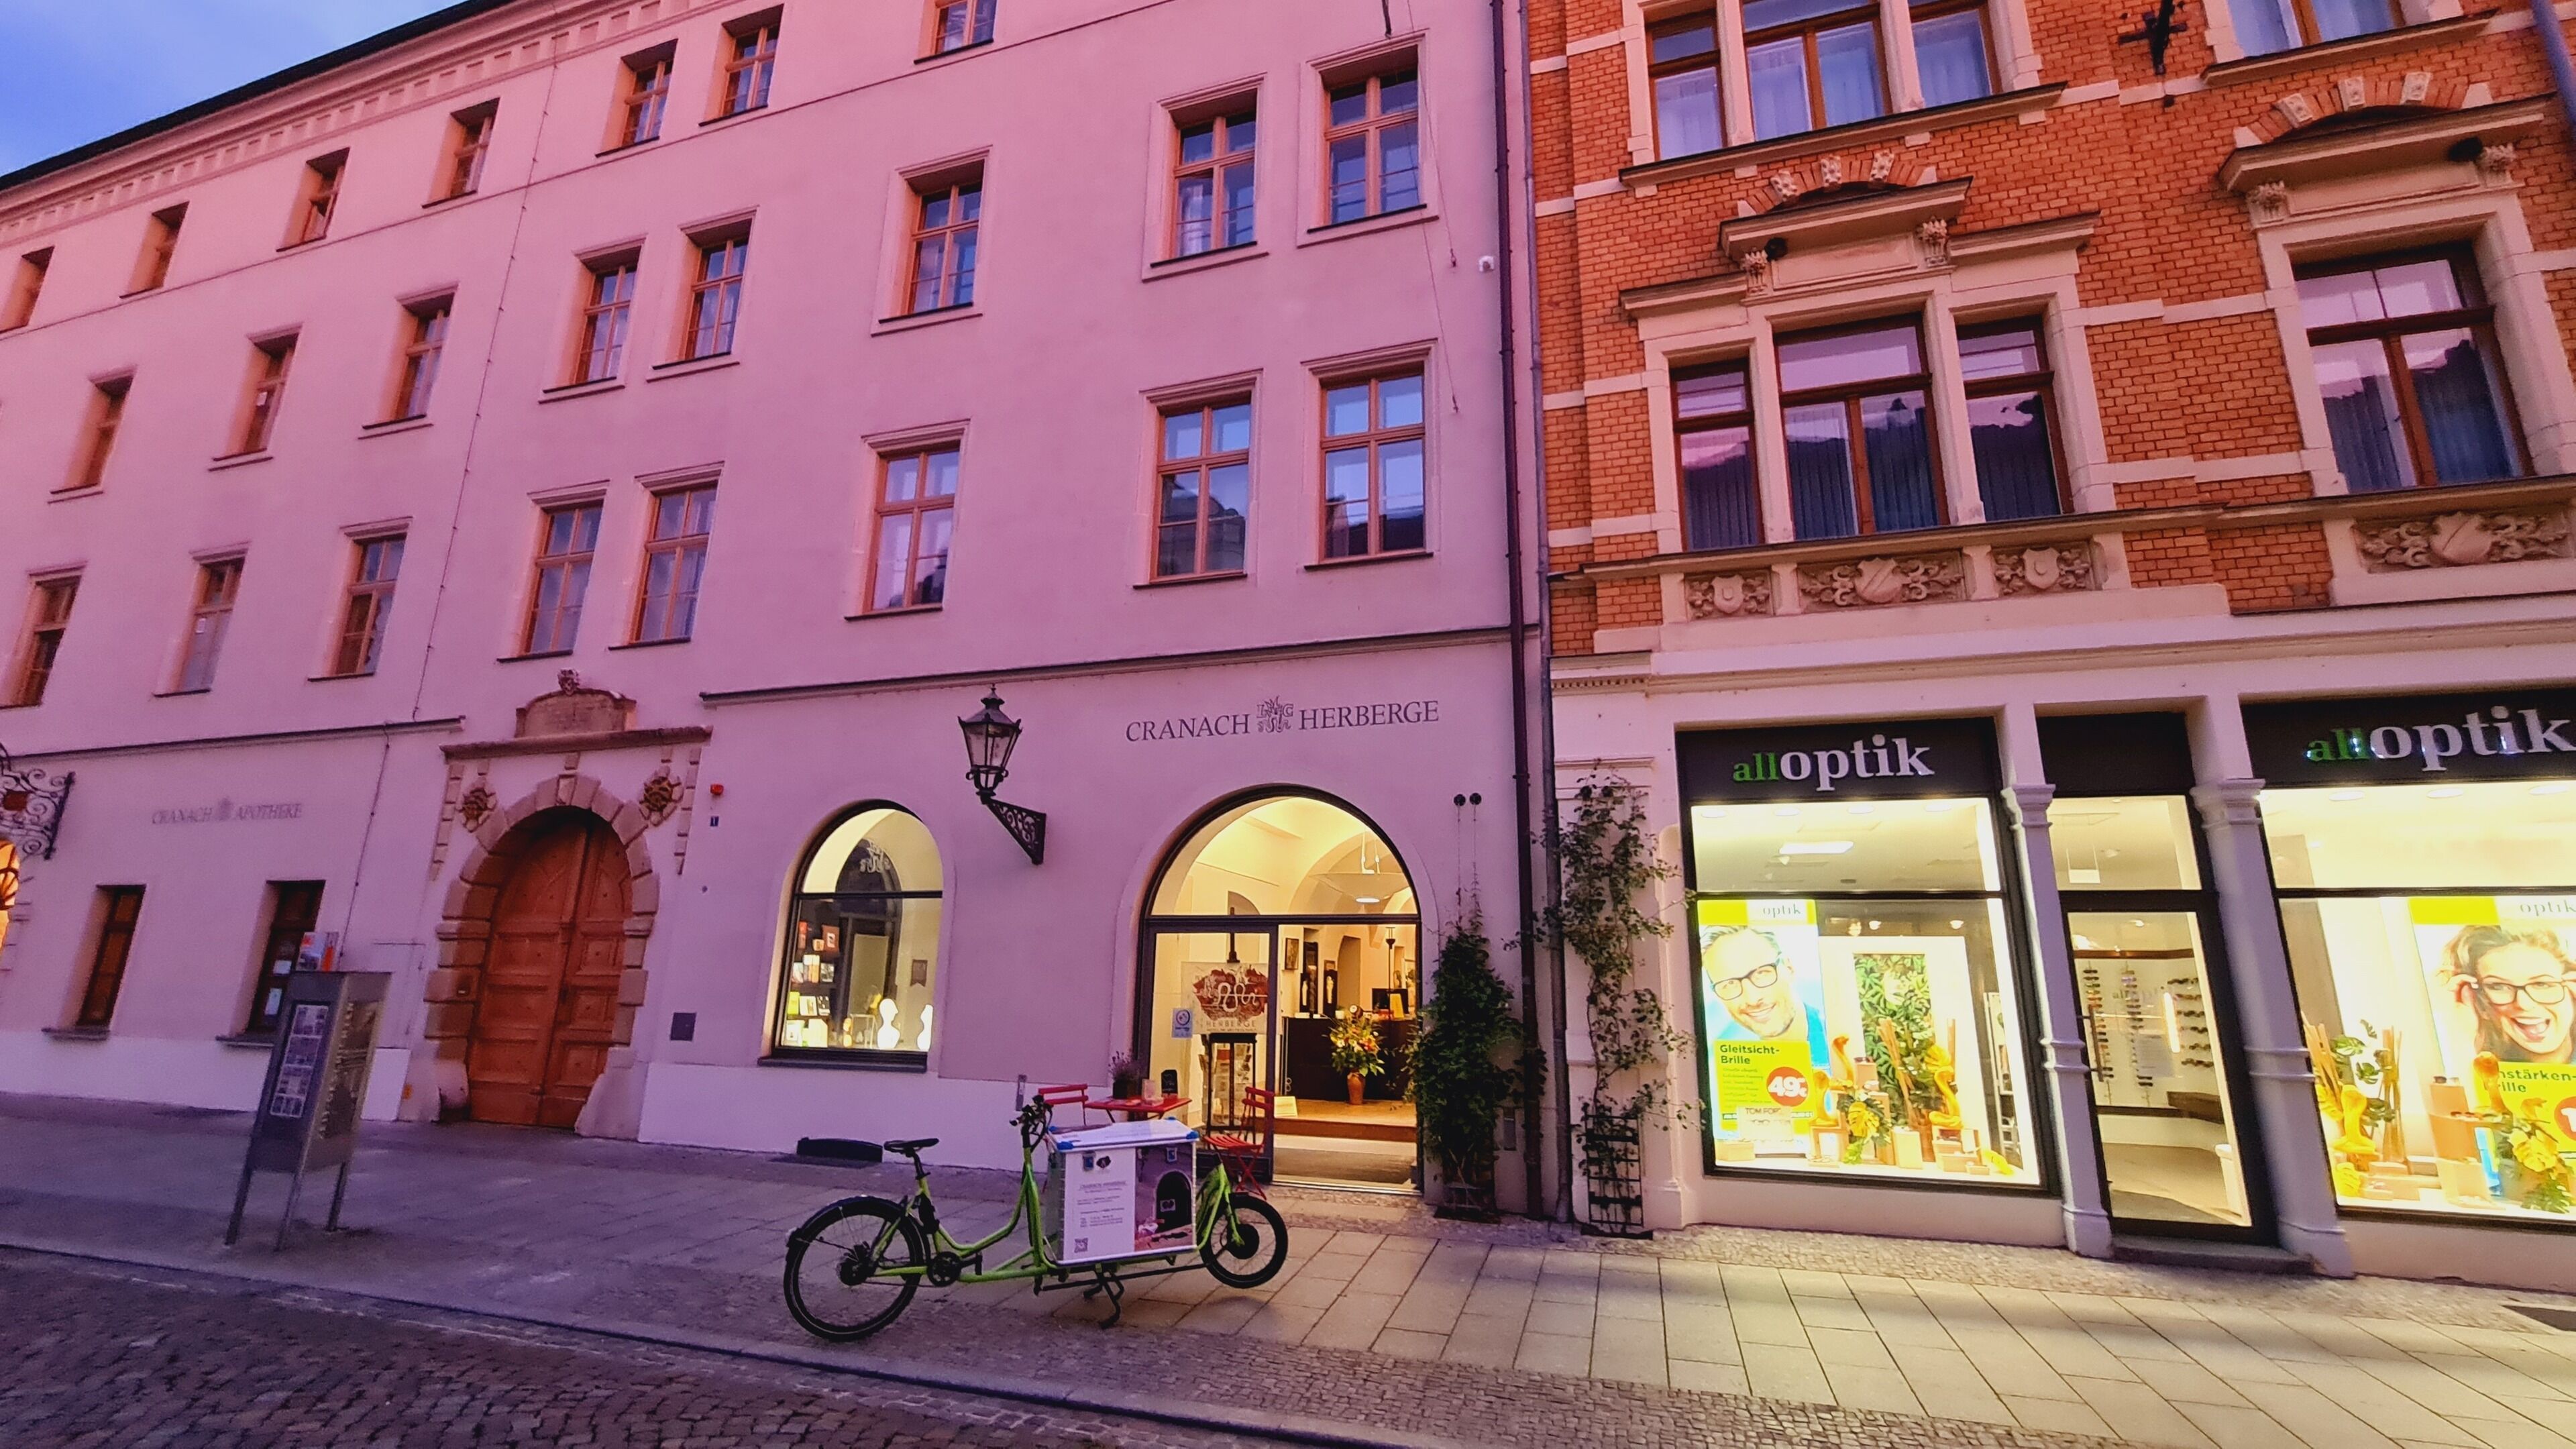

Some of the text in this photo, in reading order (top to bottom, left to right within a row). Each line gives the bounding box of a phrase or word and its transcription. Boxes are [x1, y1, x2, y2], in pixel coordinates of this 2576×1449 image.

[1126, 700, 1440, 742] CRANACH HERBERGE
[1733, 734, 1935, 792] alloptik
[1720, 1044, 1780, 1054] Gleitsicht-
[1721, 1055, 1750, 1064] Brille
[2500, 1069, 2576, 1081] nstärken-
